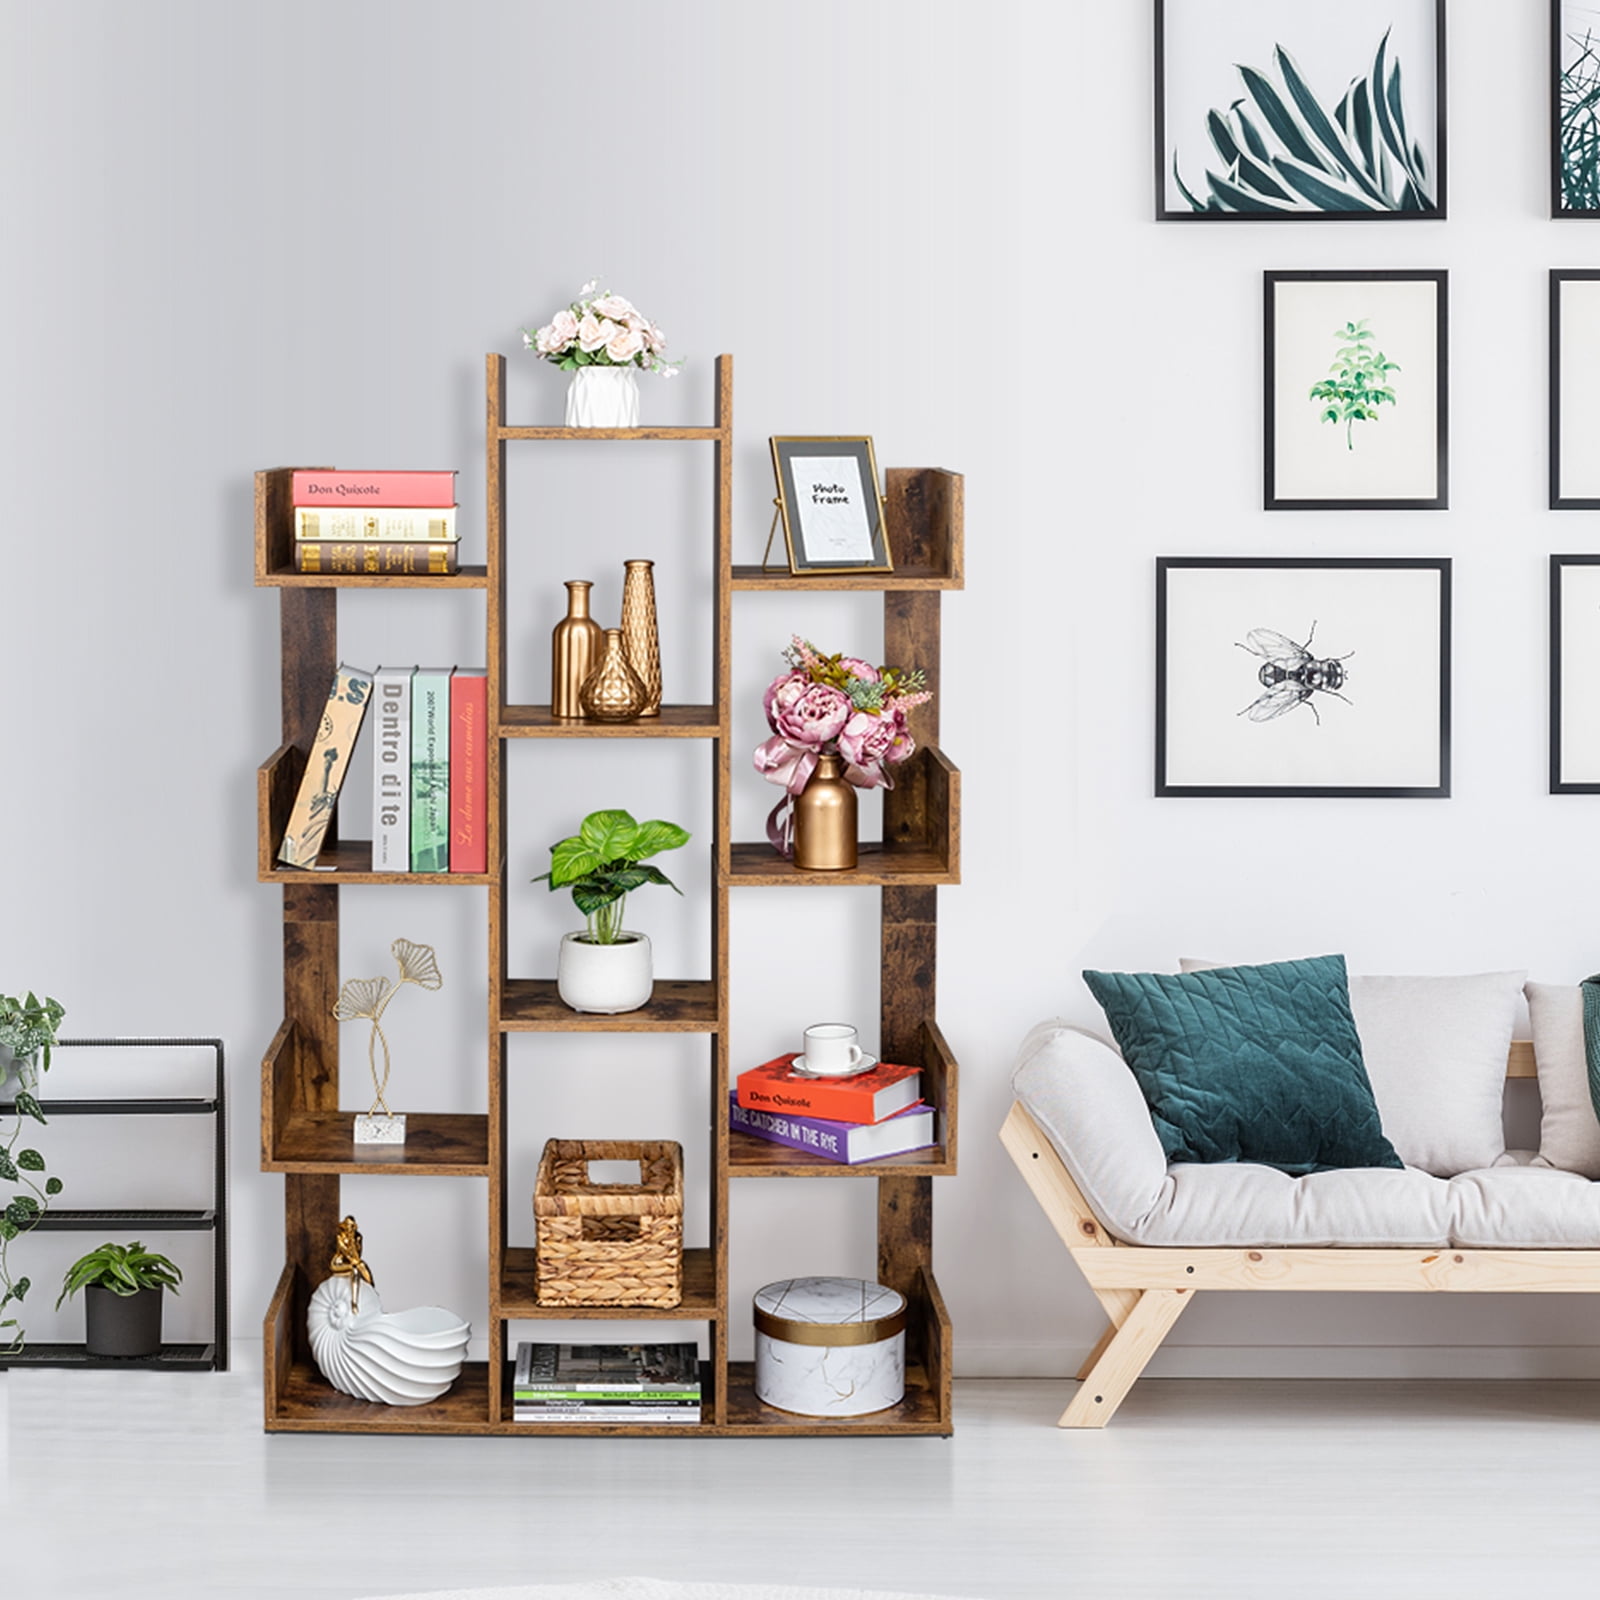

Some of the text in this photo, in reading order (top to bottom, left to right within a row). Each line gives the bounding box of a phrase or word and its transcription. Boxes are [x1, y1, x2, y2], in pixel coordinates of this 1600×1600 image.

[308, 484, 381, 496] Don Quixote
[811, 494, 850, 505] Frame
[812, 483, 846, 494] Photo
[380, 684, 403, 826] Dentro di te
[463, 760, 473, 784] aux
[459, 785, 473, 821] dame
[428, 807, 438, 832] Japan
[456, 822, 473, 847] La
[749, 1091, 811, 1109] Don Quixote
[731, 1104, 839, 1154] THE CATCHER IN THE RYE
